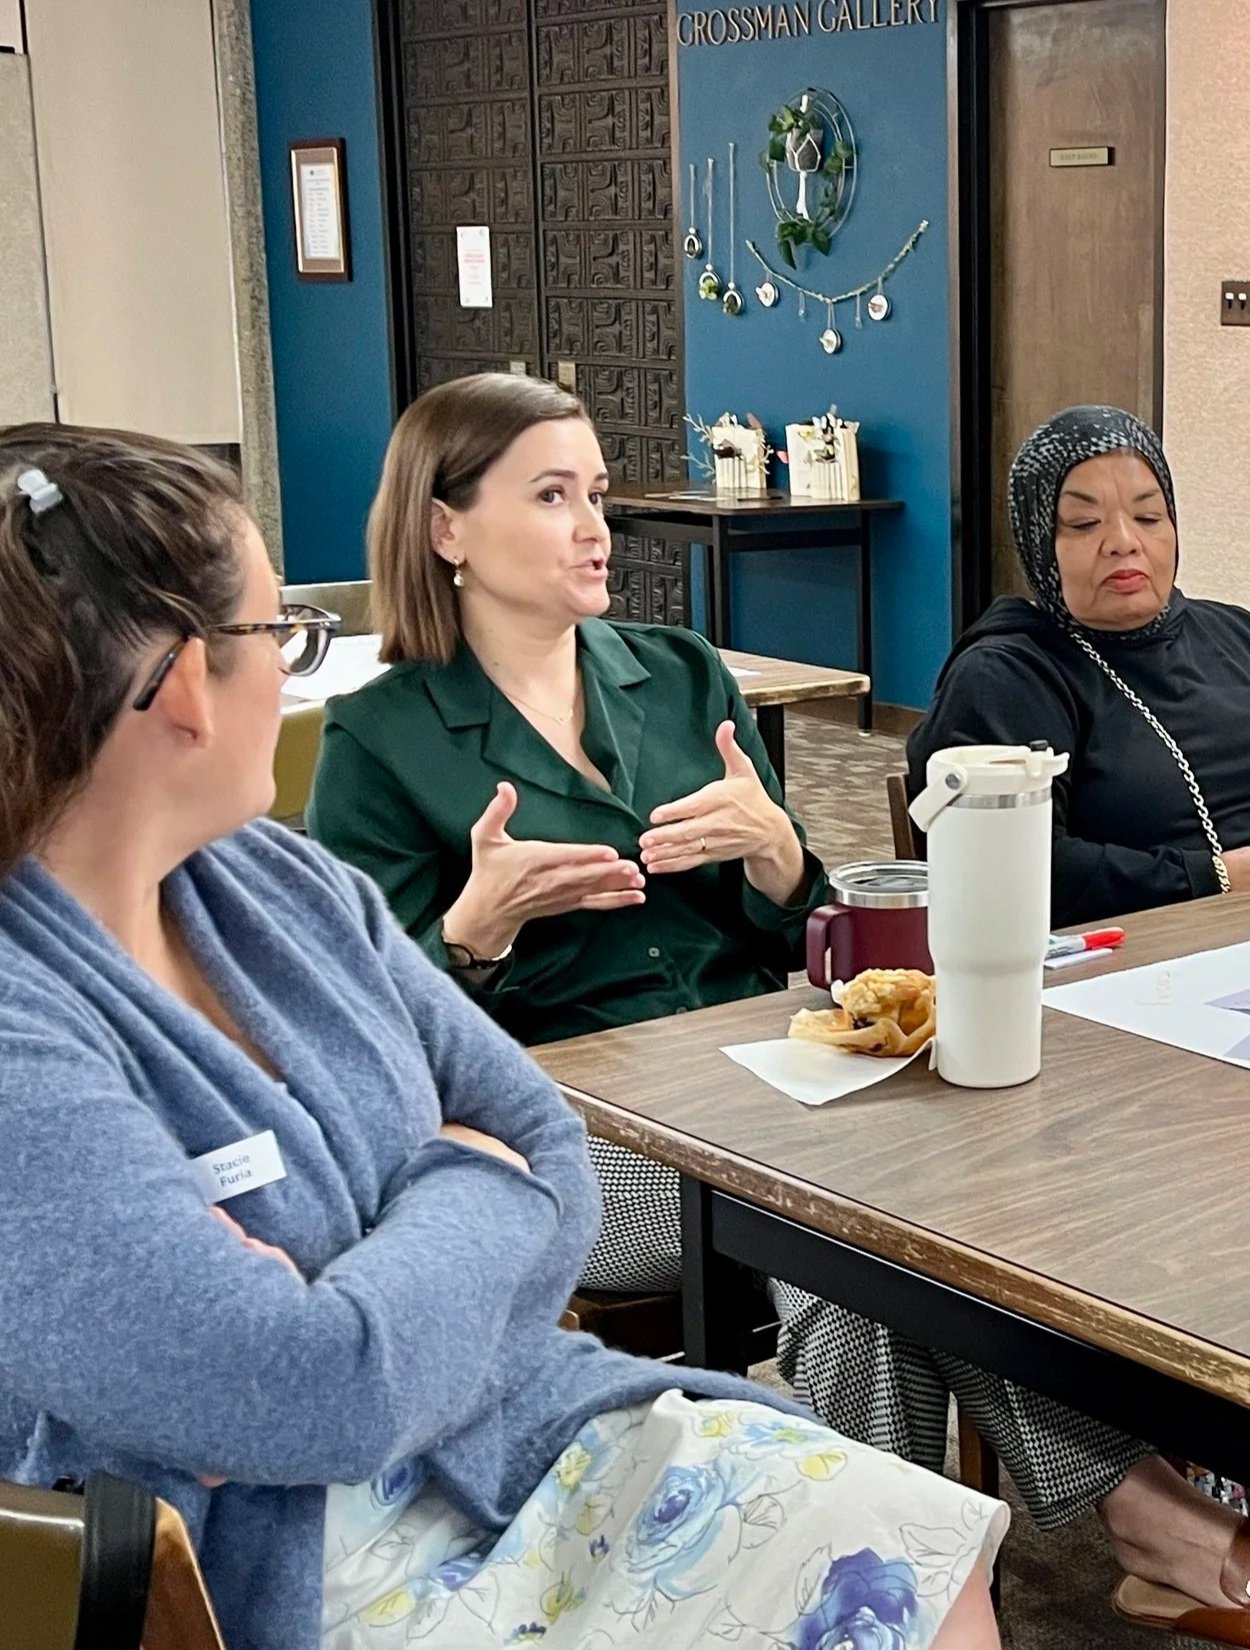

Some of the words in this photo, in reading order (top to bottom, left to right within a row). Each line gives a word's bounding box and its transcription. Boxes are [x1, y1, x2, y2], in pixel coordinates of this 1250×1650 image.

[817, 0, 939, 32] GALLERY
[212, 1155, 250, 1175] Stacie
[219, 1169, 251, 1187] Furia
